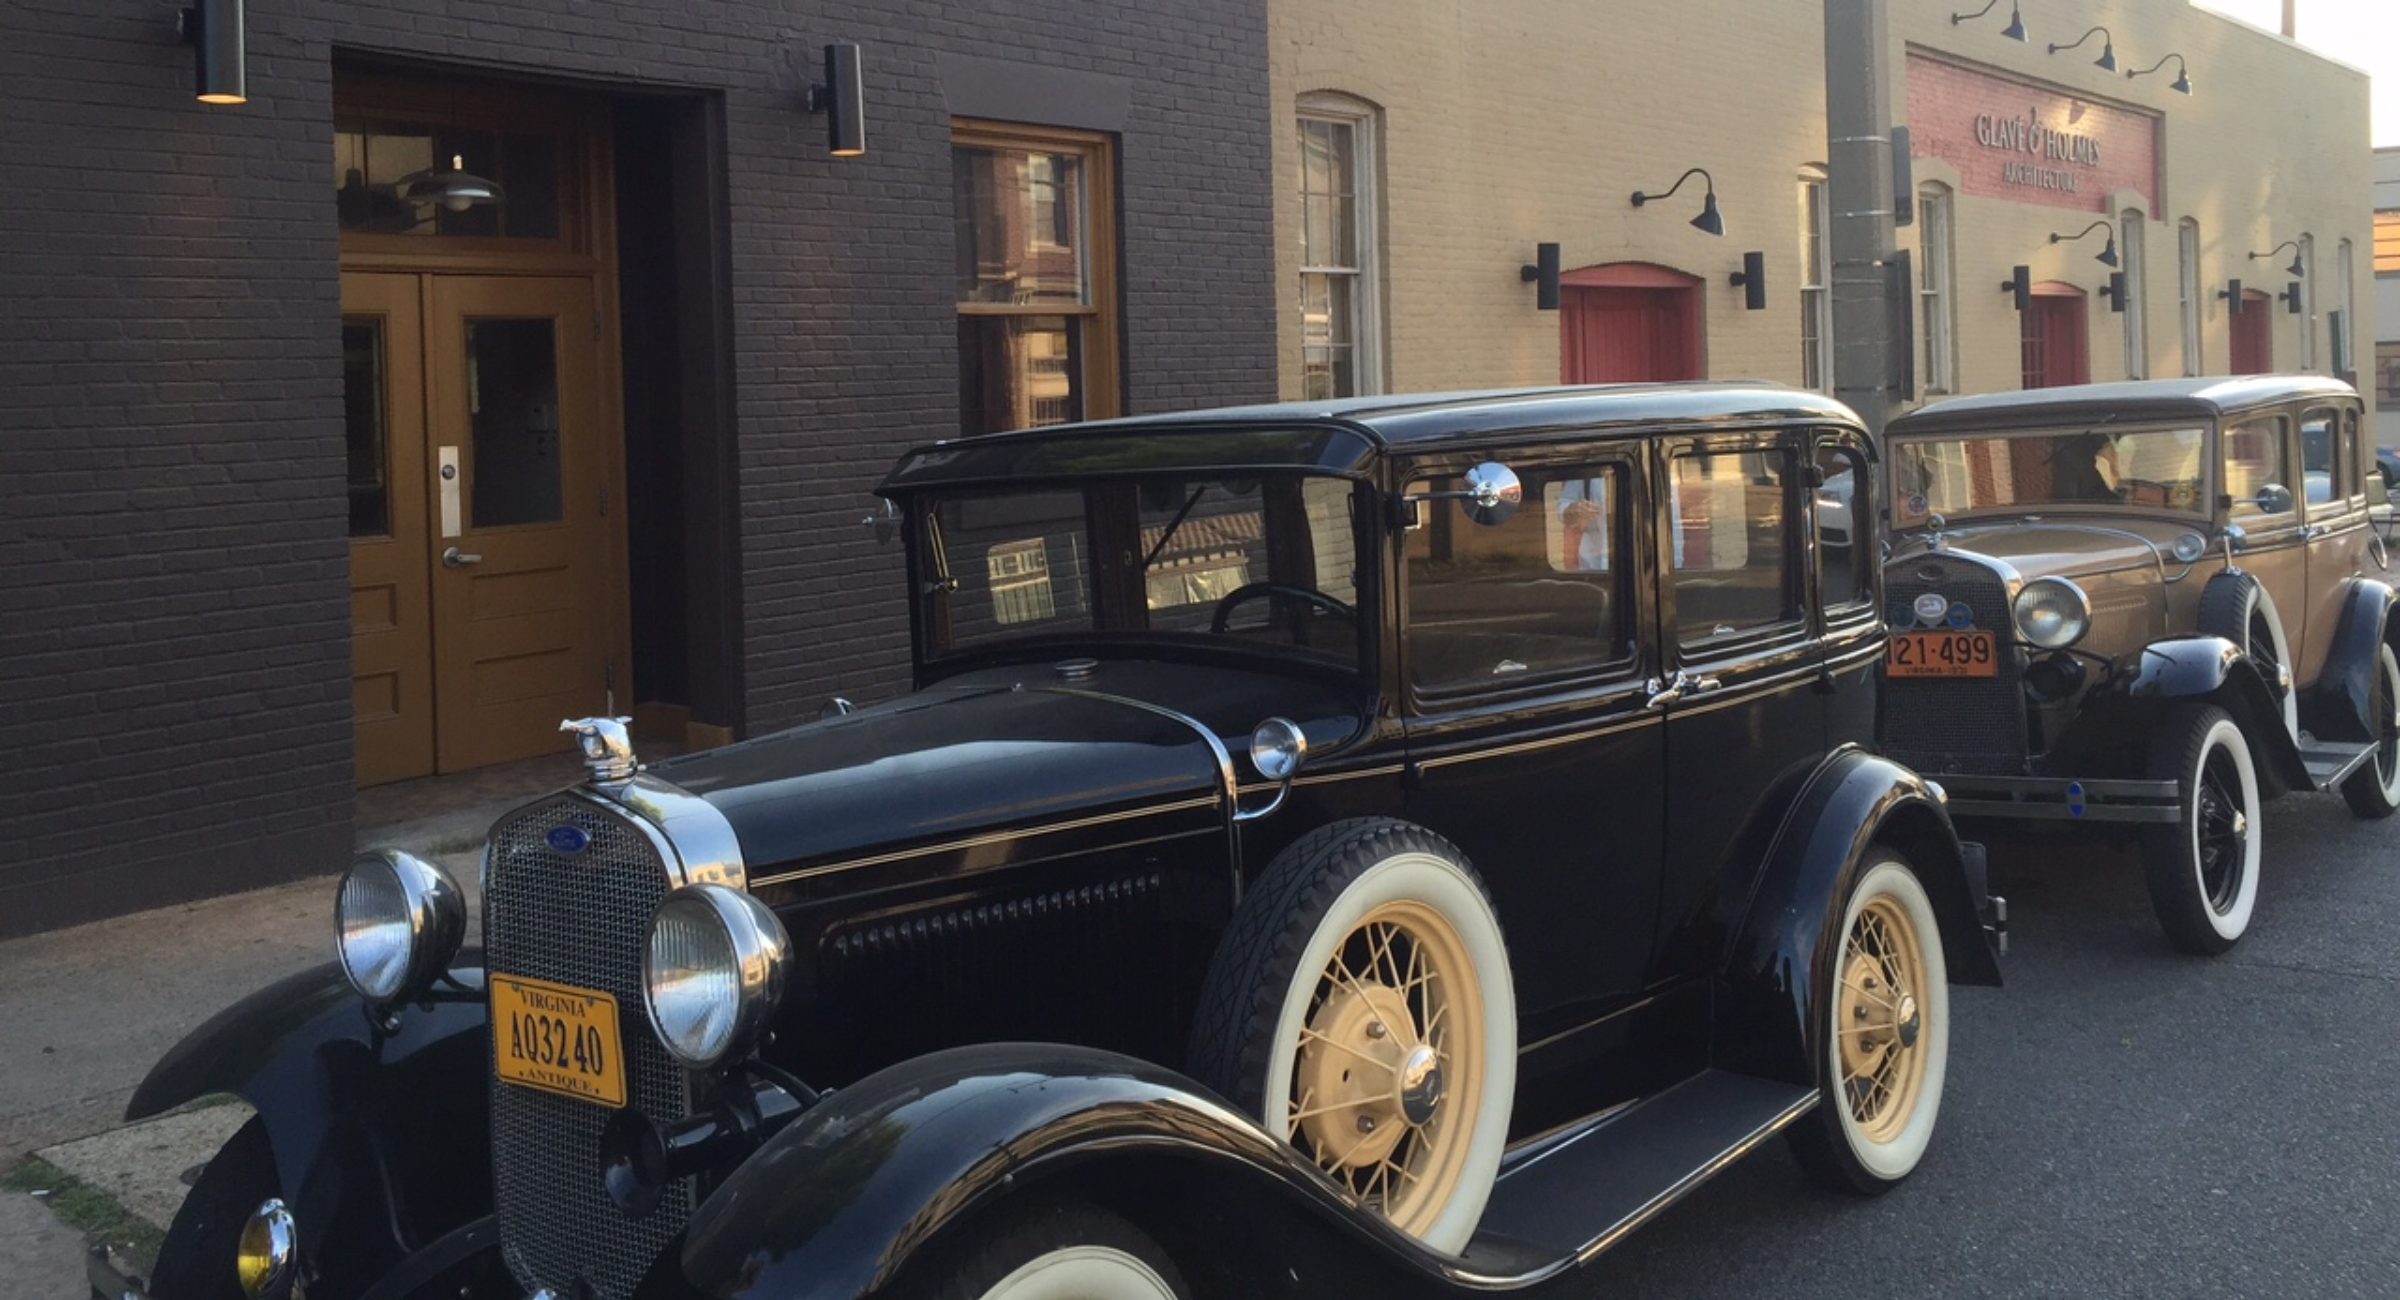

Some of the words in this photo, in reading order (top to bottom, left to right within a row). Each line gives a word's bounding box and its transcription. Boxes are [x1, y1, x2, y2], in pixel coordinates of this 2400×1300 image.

[2044, 128, 2101, 166] HOLMES
[2003, 161, 2079, 193] ARCHITECTURE
[520, 989, 587, 1018] VIRGINIA
[511, 1009, 604, 1077] AQ3240
[527, 1068, 593, 1092] ANTIQUE
